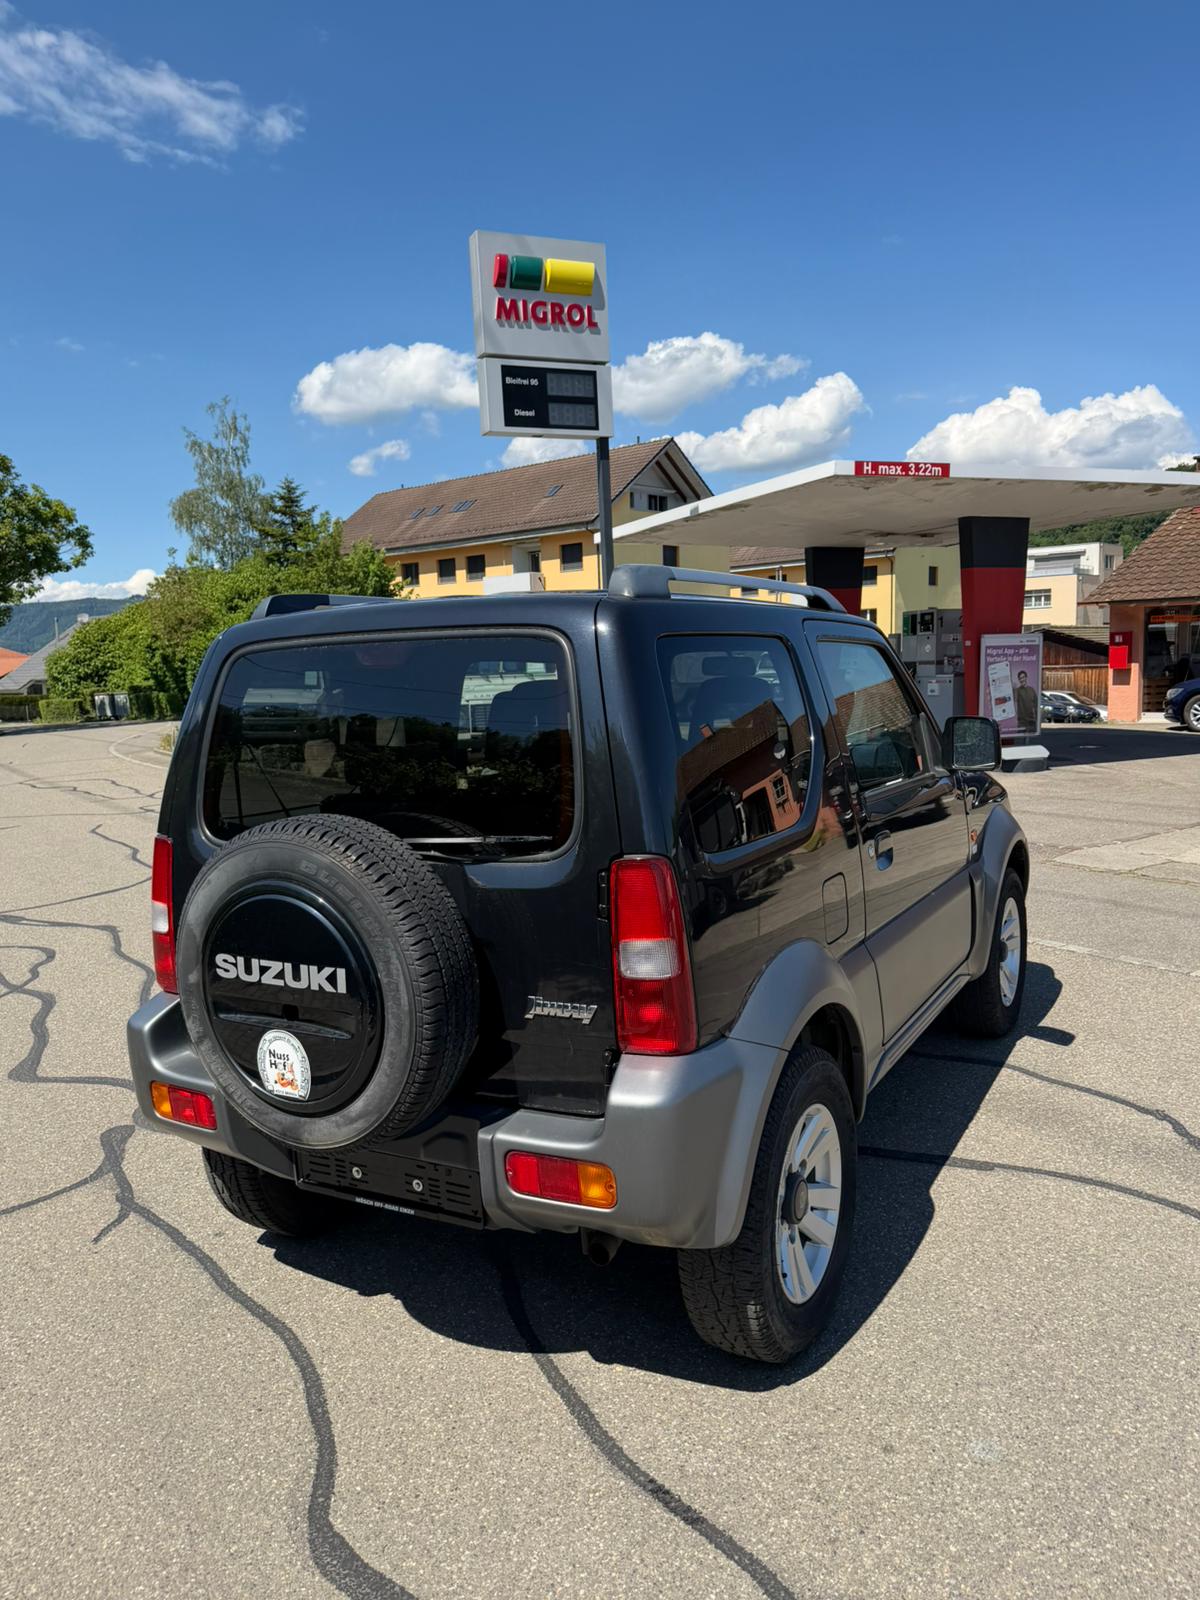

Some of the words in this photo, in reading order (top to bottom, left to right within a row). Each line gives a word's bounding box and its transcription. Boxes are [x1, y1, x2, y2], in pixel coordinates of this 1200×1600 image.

[496, 296, 598, 329] MIGROL
[505, 376, 529, 385] Bleifrei
[514, 408, 535, 416] Diesel
[863, 462, 875, 474] H.
[878, 465, 906, 475] max.
[908, 463, 942, 476] 3.22m
[215, 953, 347, 994] SUZUKI
[269, 1049, 290, 1061] Nuss
[270, 1060, 287, 1071] Hof
